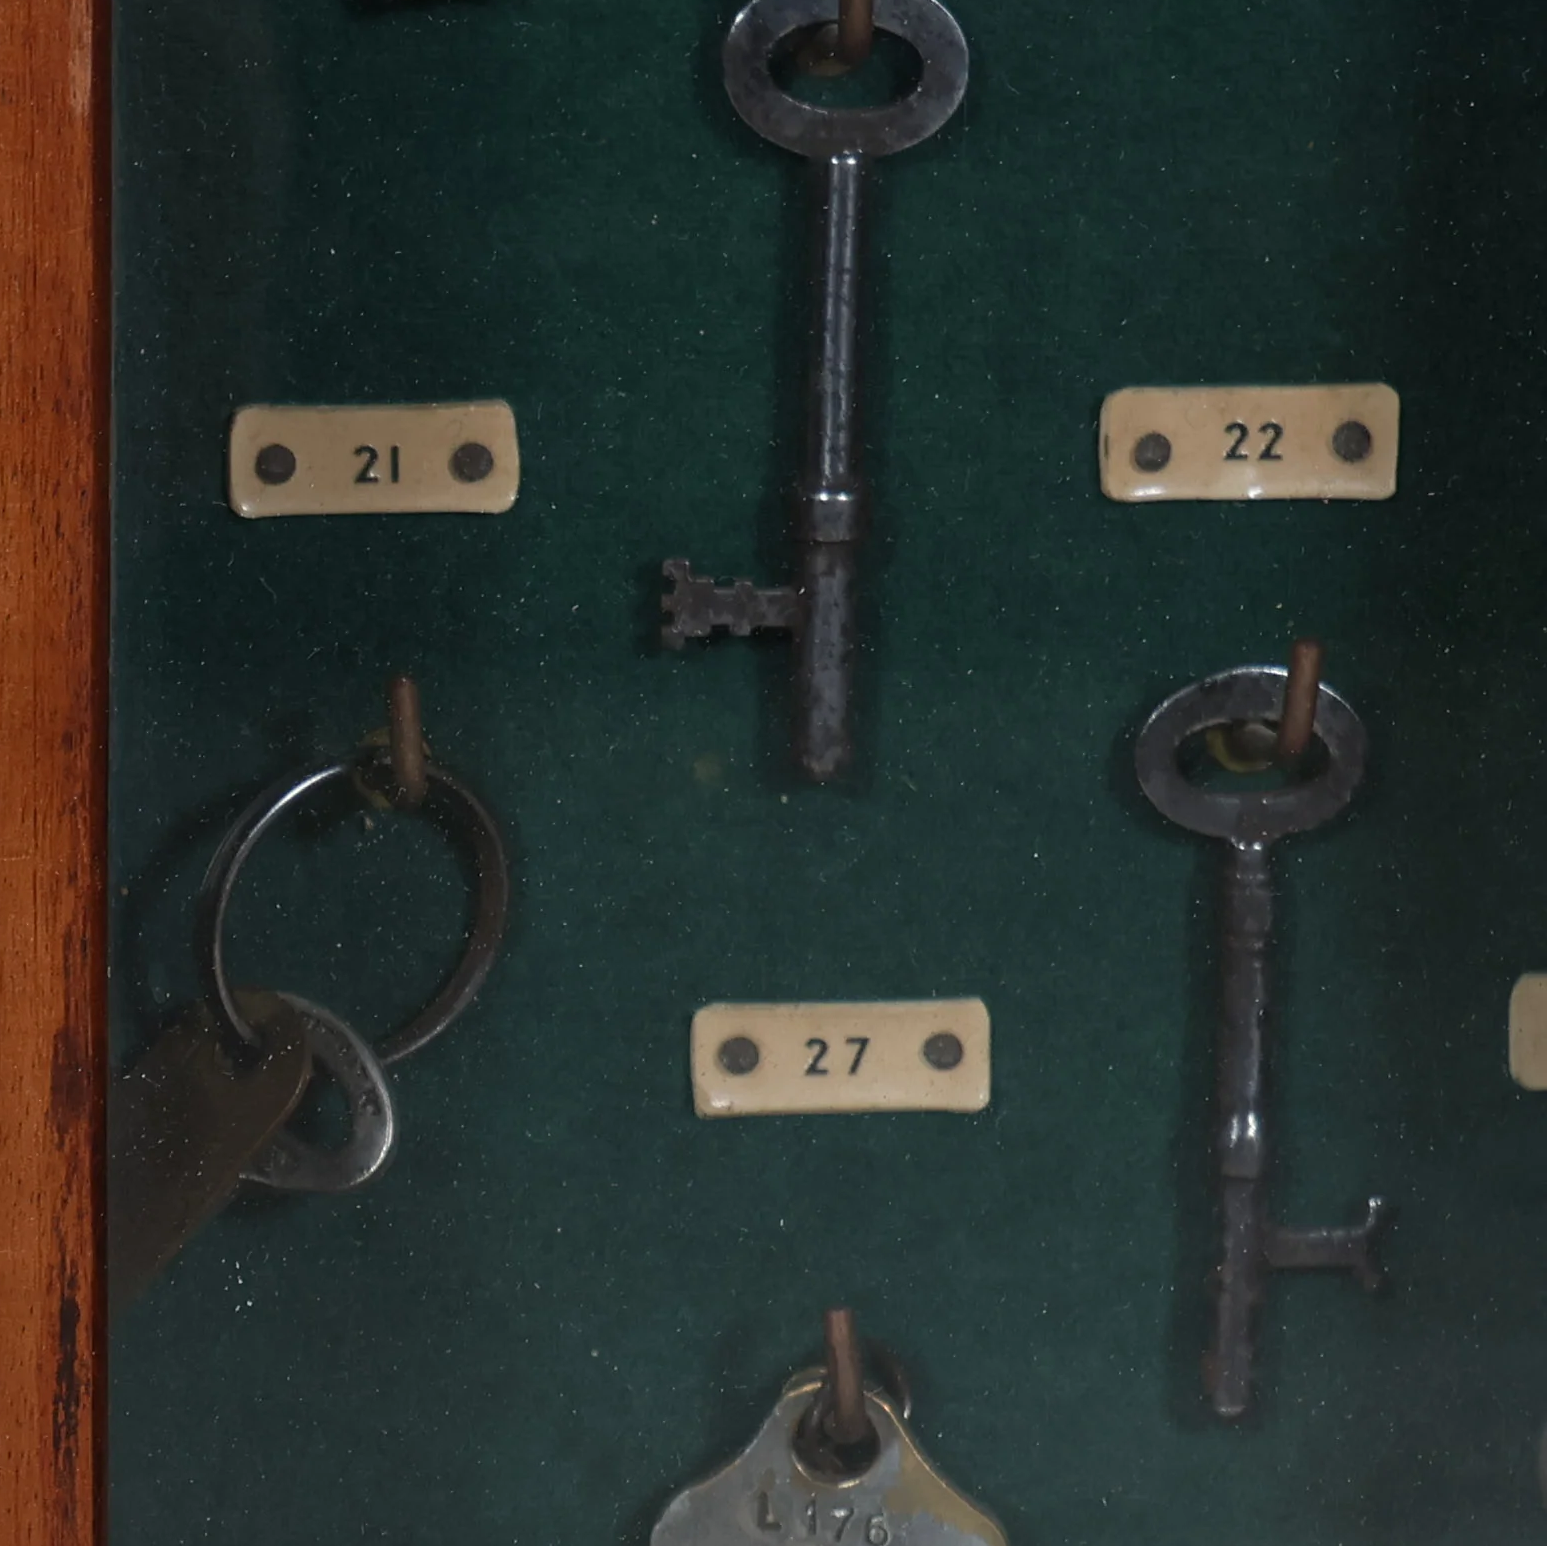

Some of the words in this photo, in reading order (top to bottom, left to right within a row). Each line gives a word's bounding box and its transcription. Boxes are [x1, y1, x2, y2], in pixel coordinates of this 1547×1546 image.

[1224, 421, 1285, 462] 22
[352, 444, 401, 485] 21
[804, 1036, 871, 1077] 27
